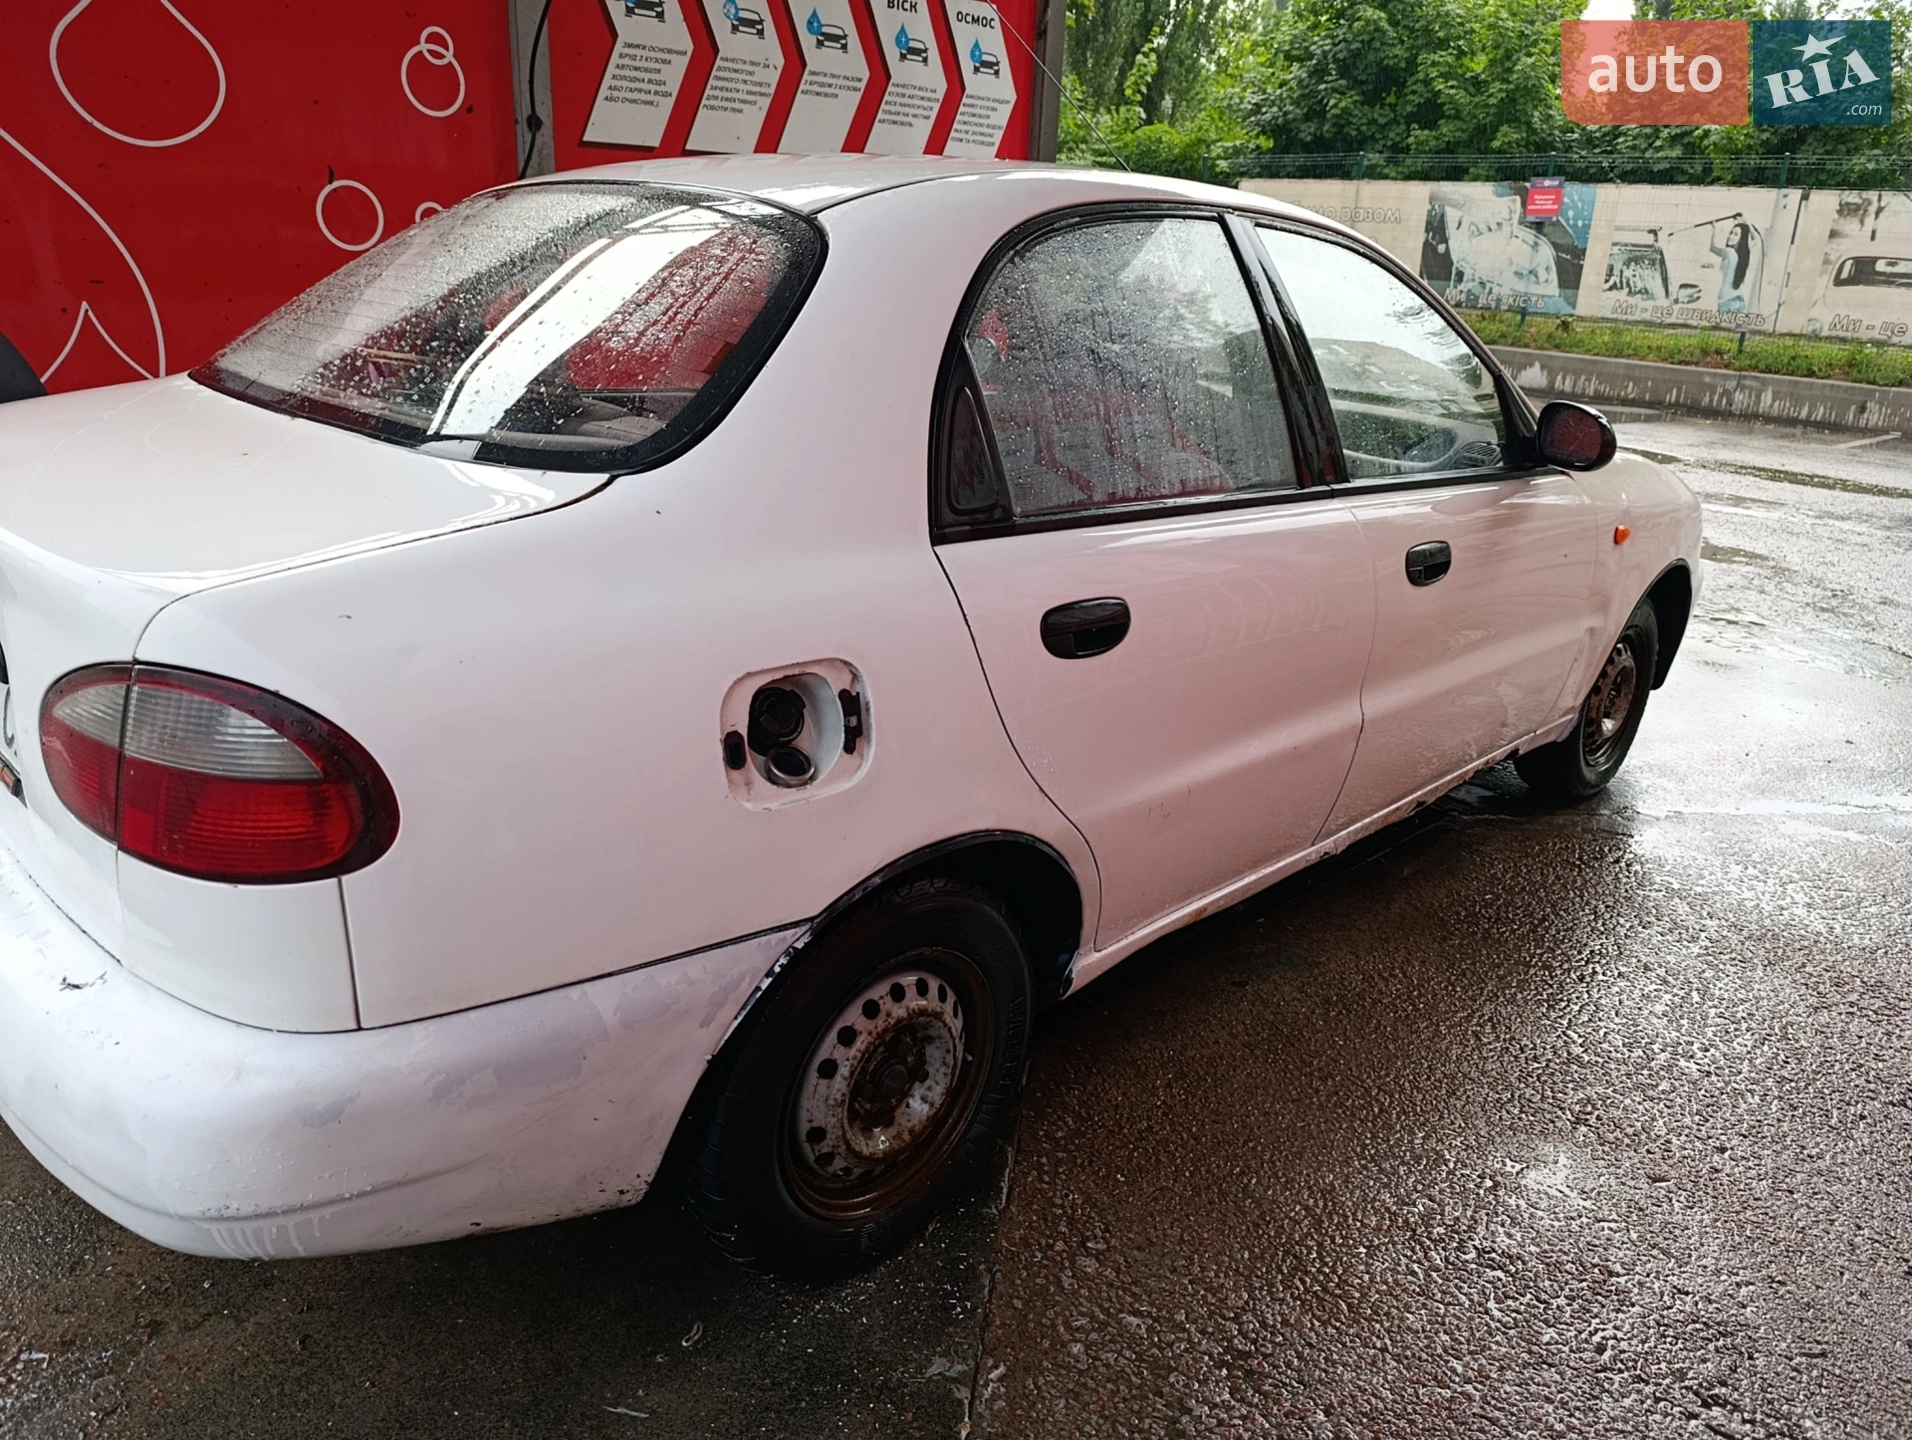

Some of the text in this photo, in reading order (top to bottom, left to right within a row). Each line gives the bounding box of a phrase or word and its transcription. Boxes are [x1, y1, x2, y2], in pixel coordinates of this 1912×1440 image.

[887, 0, 918, 14] ВІСК
[956, 11, 995, 29] ОСМОС
[622, 42, 687, 56] ЗМИТИ ОСНОВНИЙ
[619, 52, 637, 61] БРУД
[644, 56, 671, 65] КУЗОВА
[720, 56, 747, 64] НАНЕСТИ
[615, 64, 661, 74] АВТОМОБІЛЯ
[716, 66, 755, 76] ДОПОМОГОЮ
[611, 74, 666, 86] ХОЛОДНА ВОДА
[713, 75, 739, 84] ПІННОГО
[809, 80, 833, 88] БРУДОМ
[624, 87, 652, 95] ГАРЯЧА
[653, 90, 672, 98] ВОДА
[710, 85, 740, 93] ЗАЧЕКАТИ
[801, 89, 838, 98] АВТОМОБІЛЯ
[720, 96, 757, 106] ЕФЕКТИВНОЇ
[898, 102, 933, 111] НАНОСИТЬСЯ
[1340, 206, 1401, 224] разом
[1443, 288, 1466, 302] Ми
[1478, 293, 1496, 305] це
[1500, 295, 1545, 308] якість
[1611, 299, 1637, 314] Ми
[1651, 305, 1674, 318] це
[1676, 308, 1765, 326] швидкість
[1828, 314, 1862, 333] Ми
[1878, 321, 1908, 338] це
